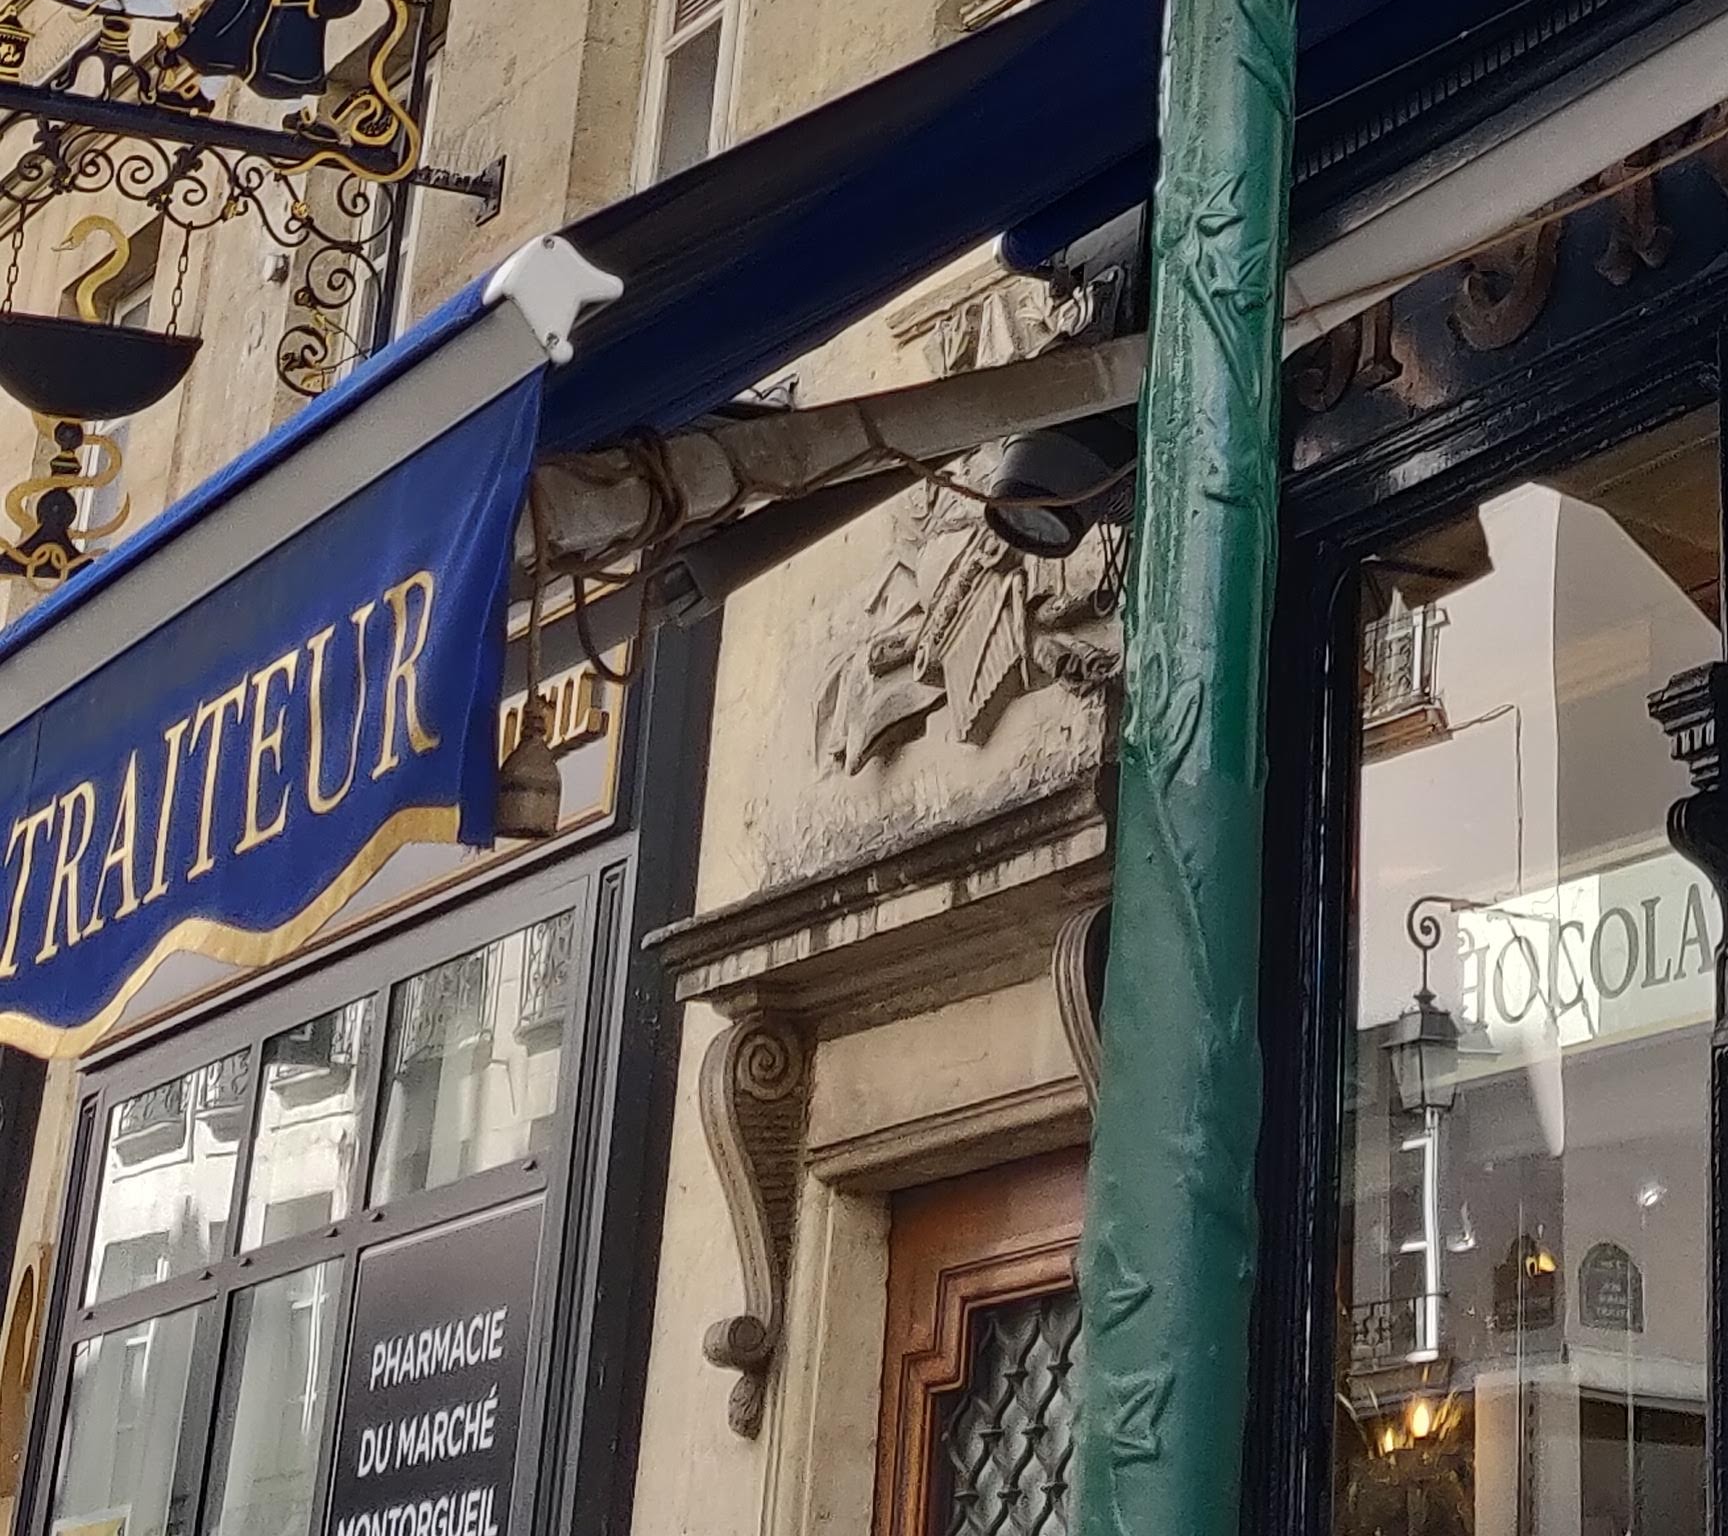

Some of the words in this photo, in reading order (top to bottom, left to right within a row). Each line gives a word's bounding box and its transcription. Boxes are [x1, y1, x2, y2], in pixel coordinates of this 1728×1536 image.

[0, 569, 442, 980] TRAITEUR
[1456, 880, 1716, 1030] HOCOLA
[369, 1303, 508, 1392] PHARMACIE
[357, 1419, 394, 1478] DU
[394, 1380, 500, 1470] MARCHÉ
